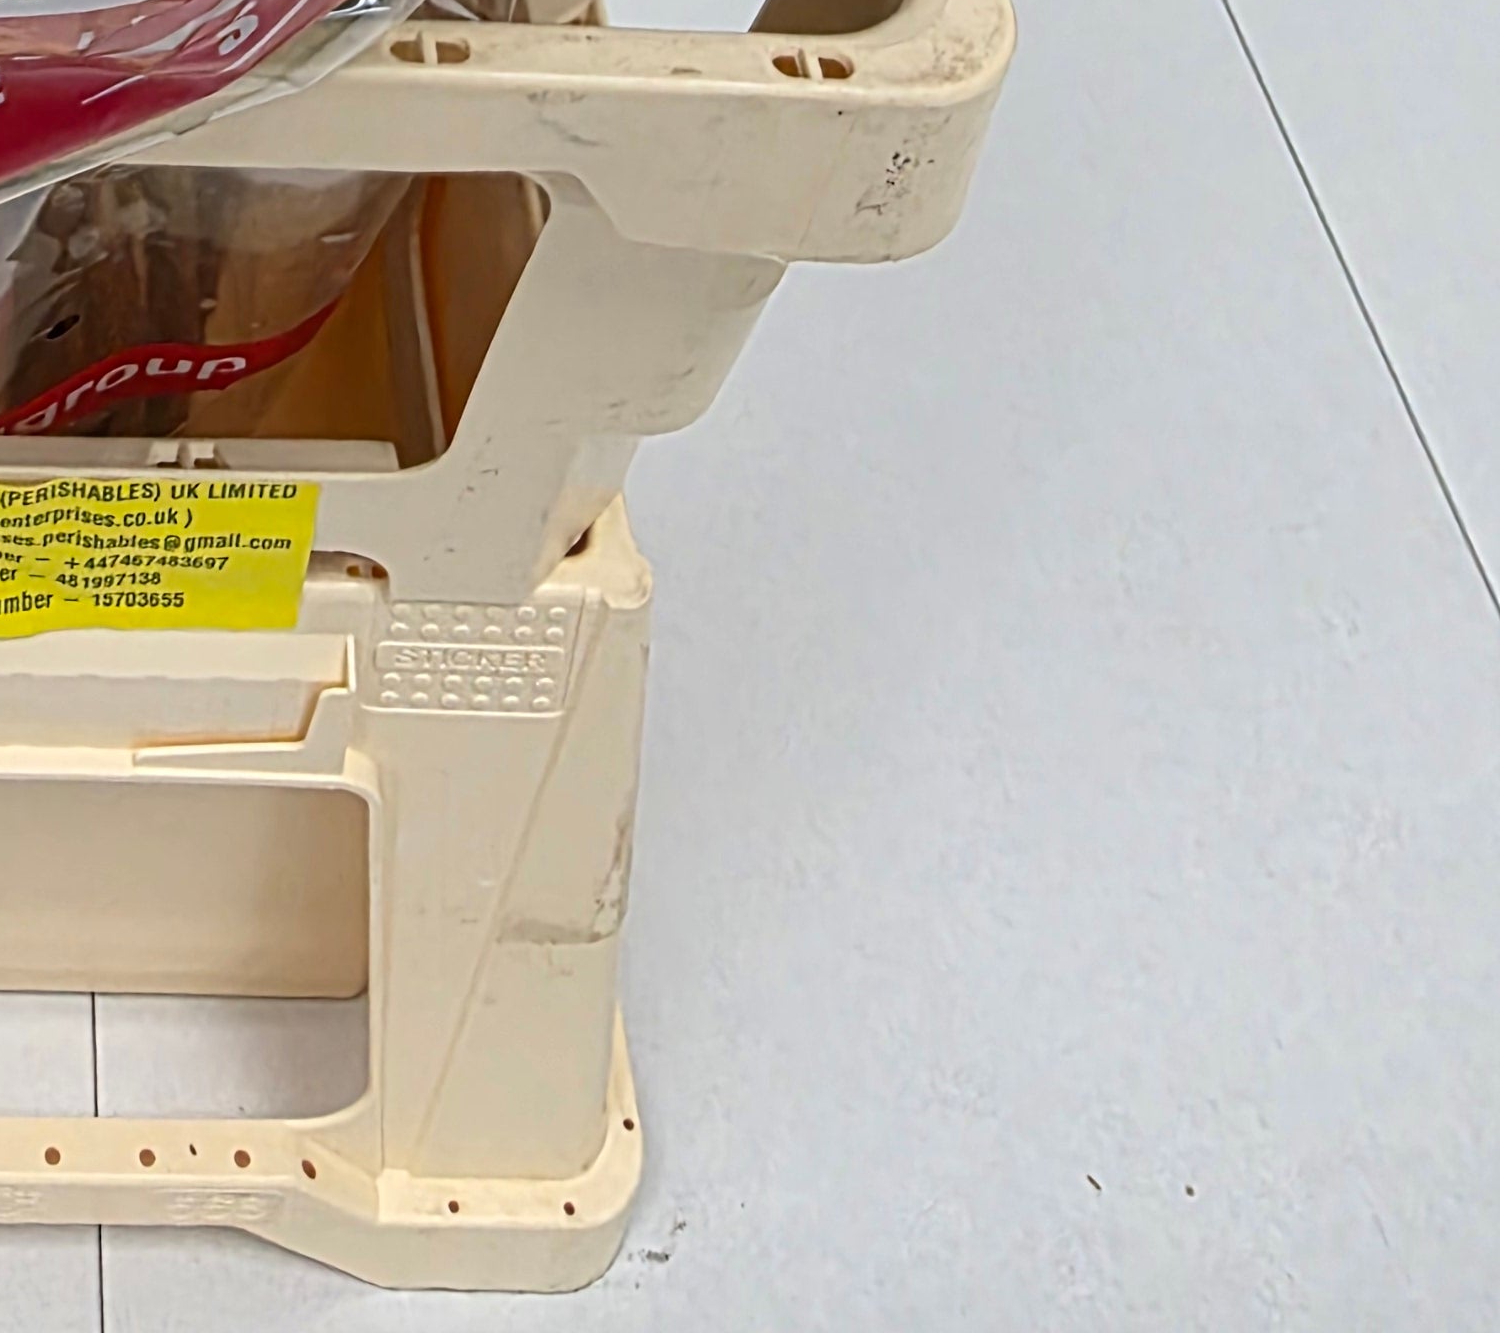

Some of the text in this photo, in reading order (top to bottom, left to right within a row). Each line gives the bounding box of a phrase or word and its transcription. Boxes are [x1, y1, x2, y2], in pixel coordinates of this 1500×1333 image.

[0, 482, 161, 510] (PERISHABLES)
[170, 483, 200, 500] UK
[207, 483, 298, 501] LIMITED
[55, 571, 162, 589] 481997138
[92, 590, 185, 608] 15703655
